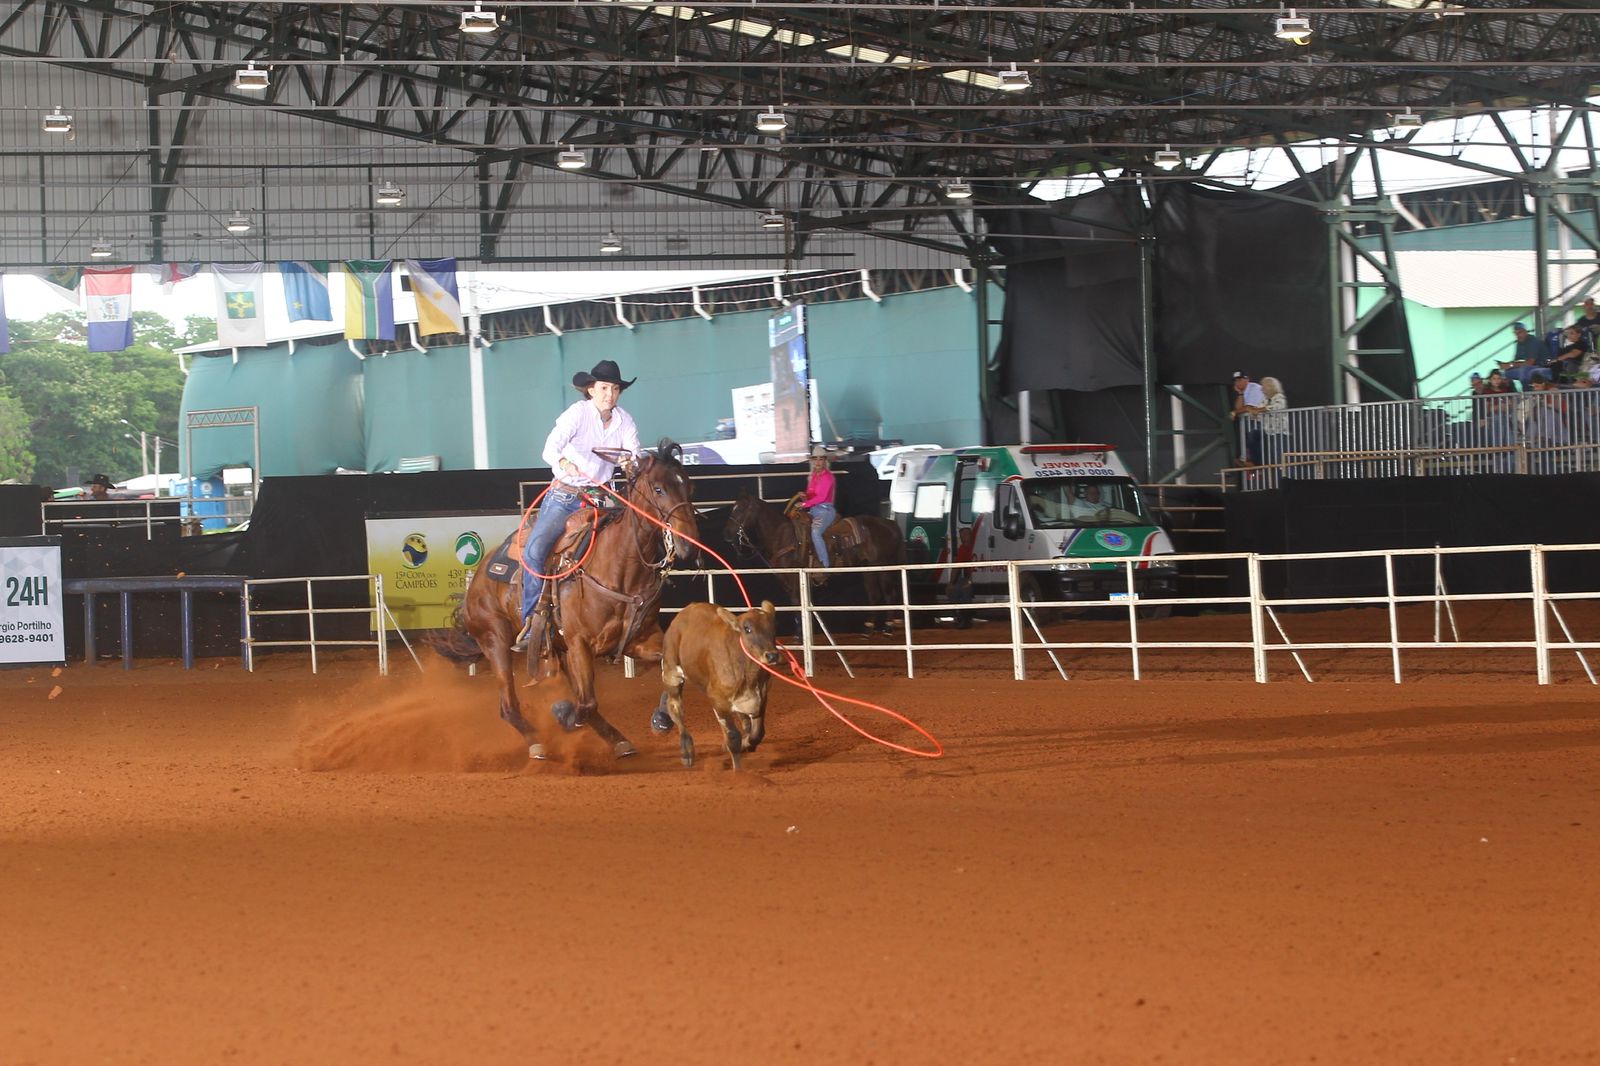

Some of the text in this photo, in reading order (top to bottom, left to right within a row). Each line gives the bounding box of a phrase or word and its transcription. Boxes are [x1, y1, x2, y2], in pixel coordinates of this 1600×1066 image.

[7, 576, 48, 606] 24H
[17, 621, 51, 630] Portilho
[0, 634, 53, 643] 9628-9401
